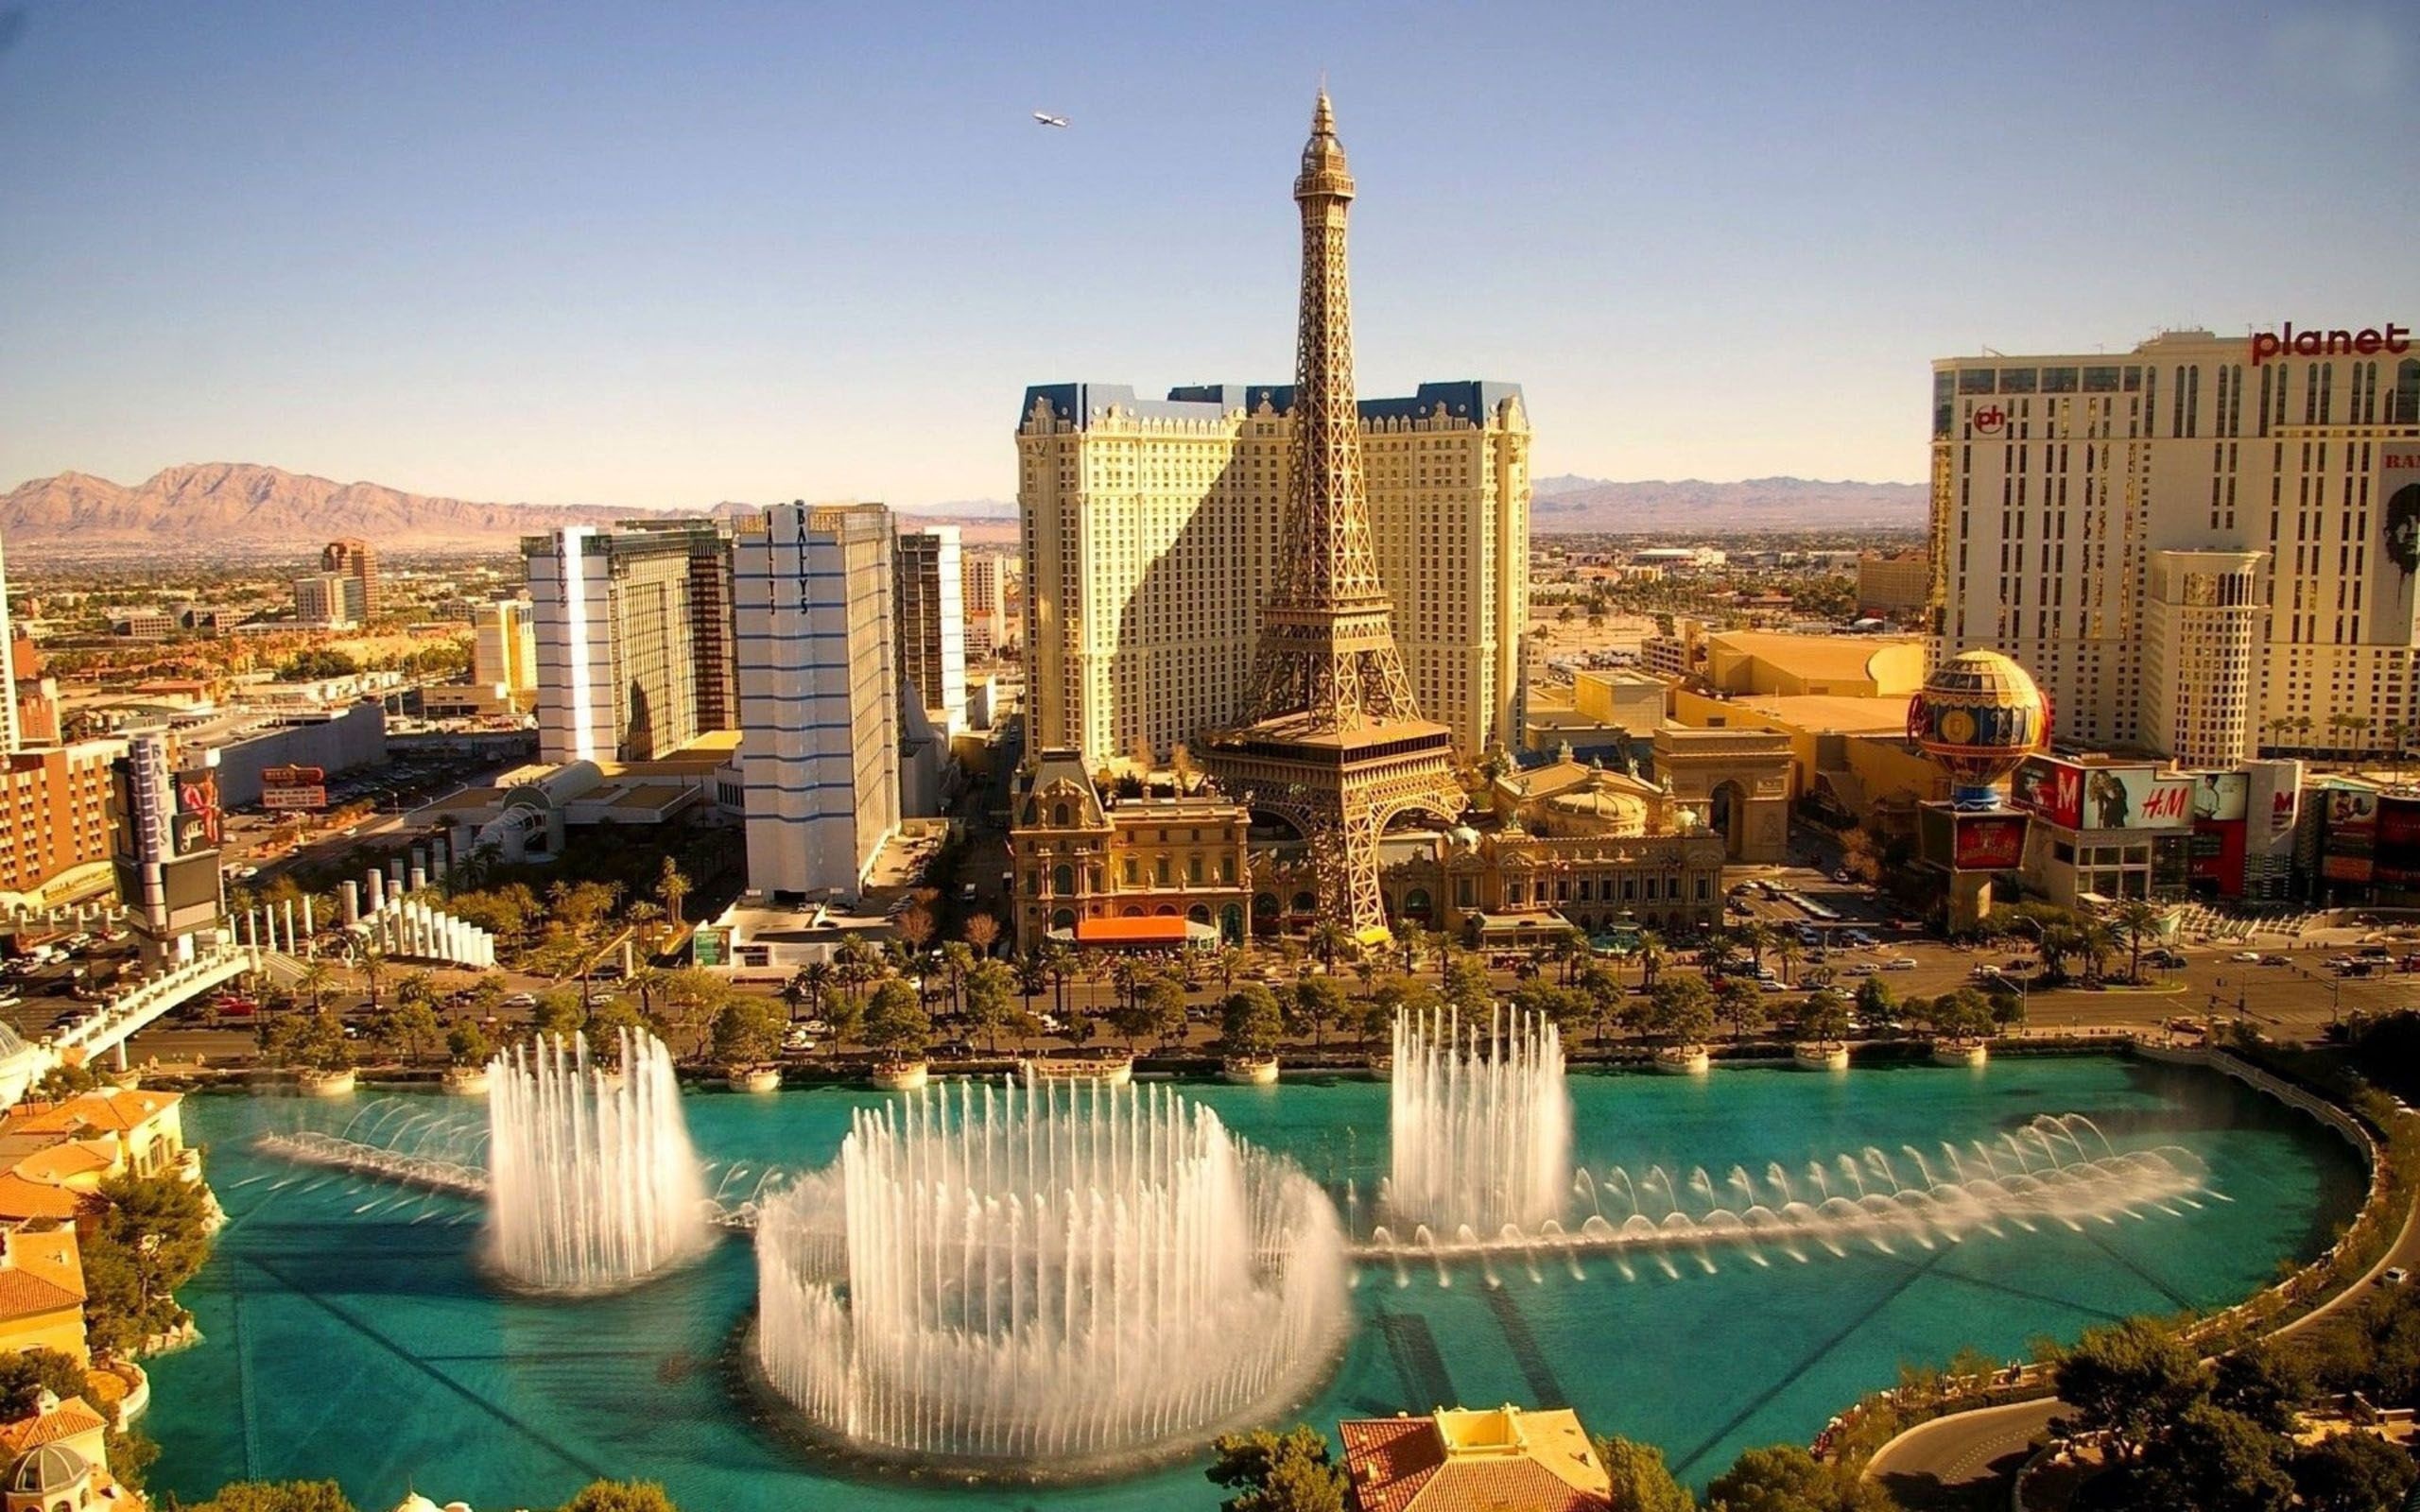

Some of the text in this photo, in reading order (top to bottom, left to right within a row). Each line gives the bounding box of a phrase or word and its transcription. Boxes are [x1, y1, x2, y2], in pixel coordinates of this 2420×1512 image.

[2253, 321, 2410, 366] planet
[1977, 404, 2005, 431] ph
[2386, 455, 2420, 469] RA
[2141, 787, 2188, 819] H&M
